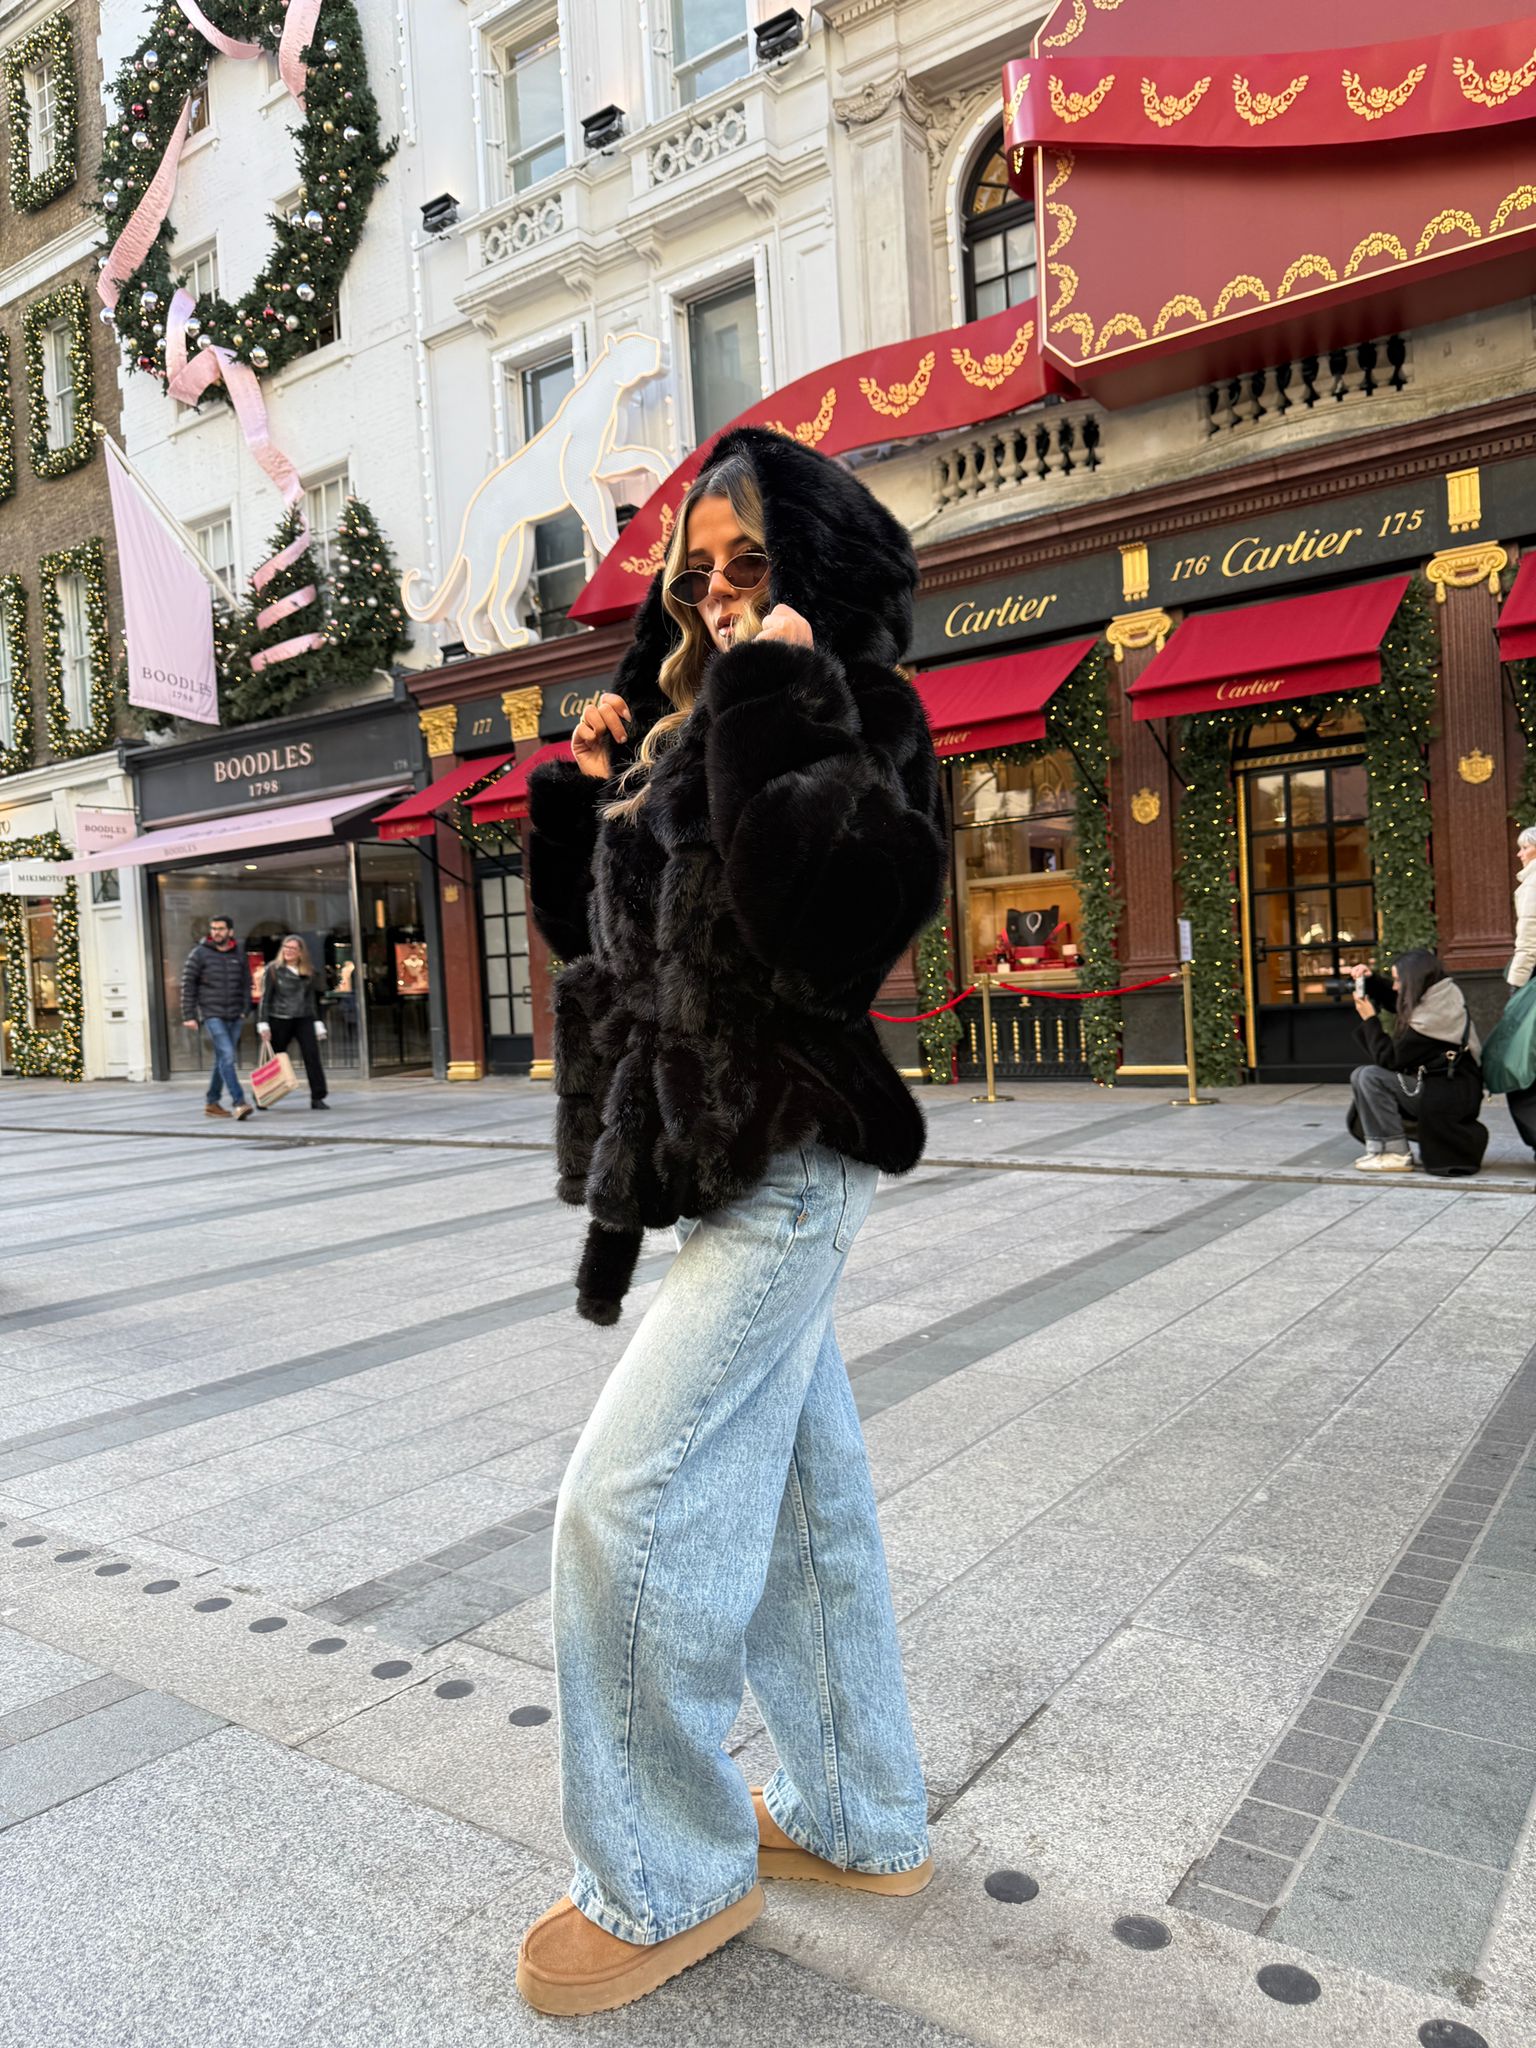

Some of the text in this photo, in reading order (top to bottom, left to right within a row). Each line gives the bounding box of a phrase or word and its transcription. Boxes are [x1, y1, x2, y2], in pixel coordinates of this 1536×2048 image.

[1170, 509, 1425, 582] 176 Cartier 175
[944, 594, 1058, 638] Cartier
[1216, 679, 1285, 701] Cartier
[213, 742, 313, 783] BOODLES
[248, 780, 279, 797] 1798
[85, 824, 128, 834] BOODLES
